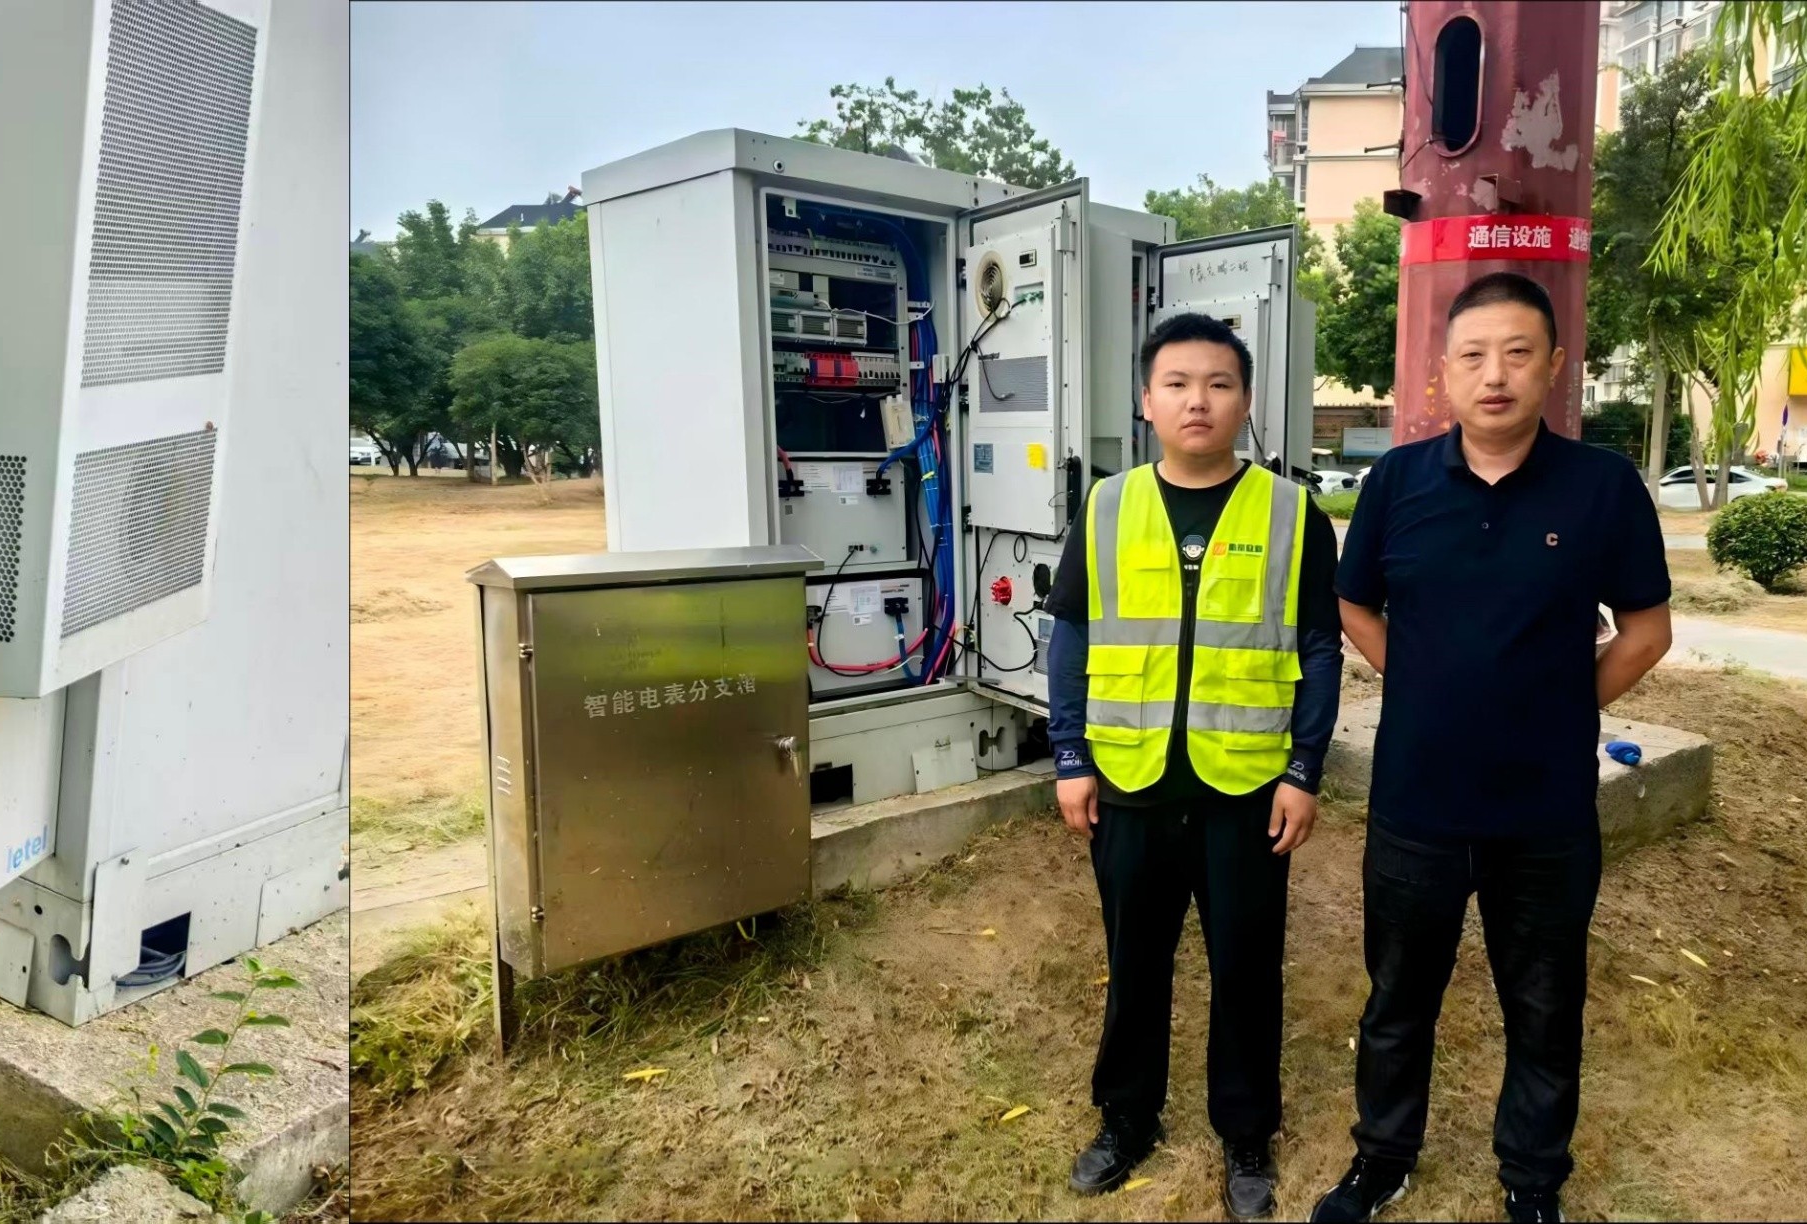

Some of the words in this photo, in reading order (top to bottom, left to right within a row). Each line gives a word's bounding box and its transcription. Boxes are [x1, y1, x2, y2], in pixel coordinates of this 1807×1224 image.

[1468, 225, 1552, 249] 通信设施
[6, 824, 48, 873] letel
